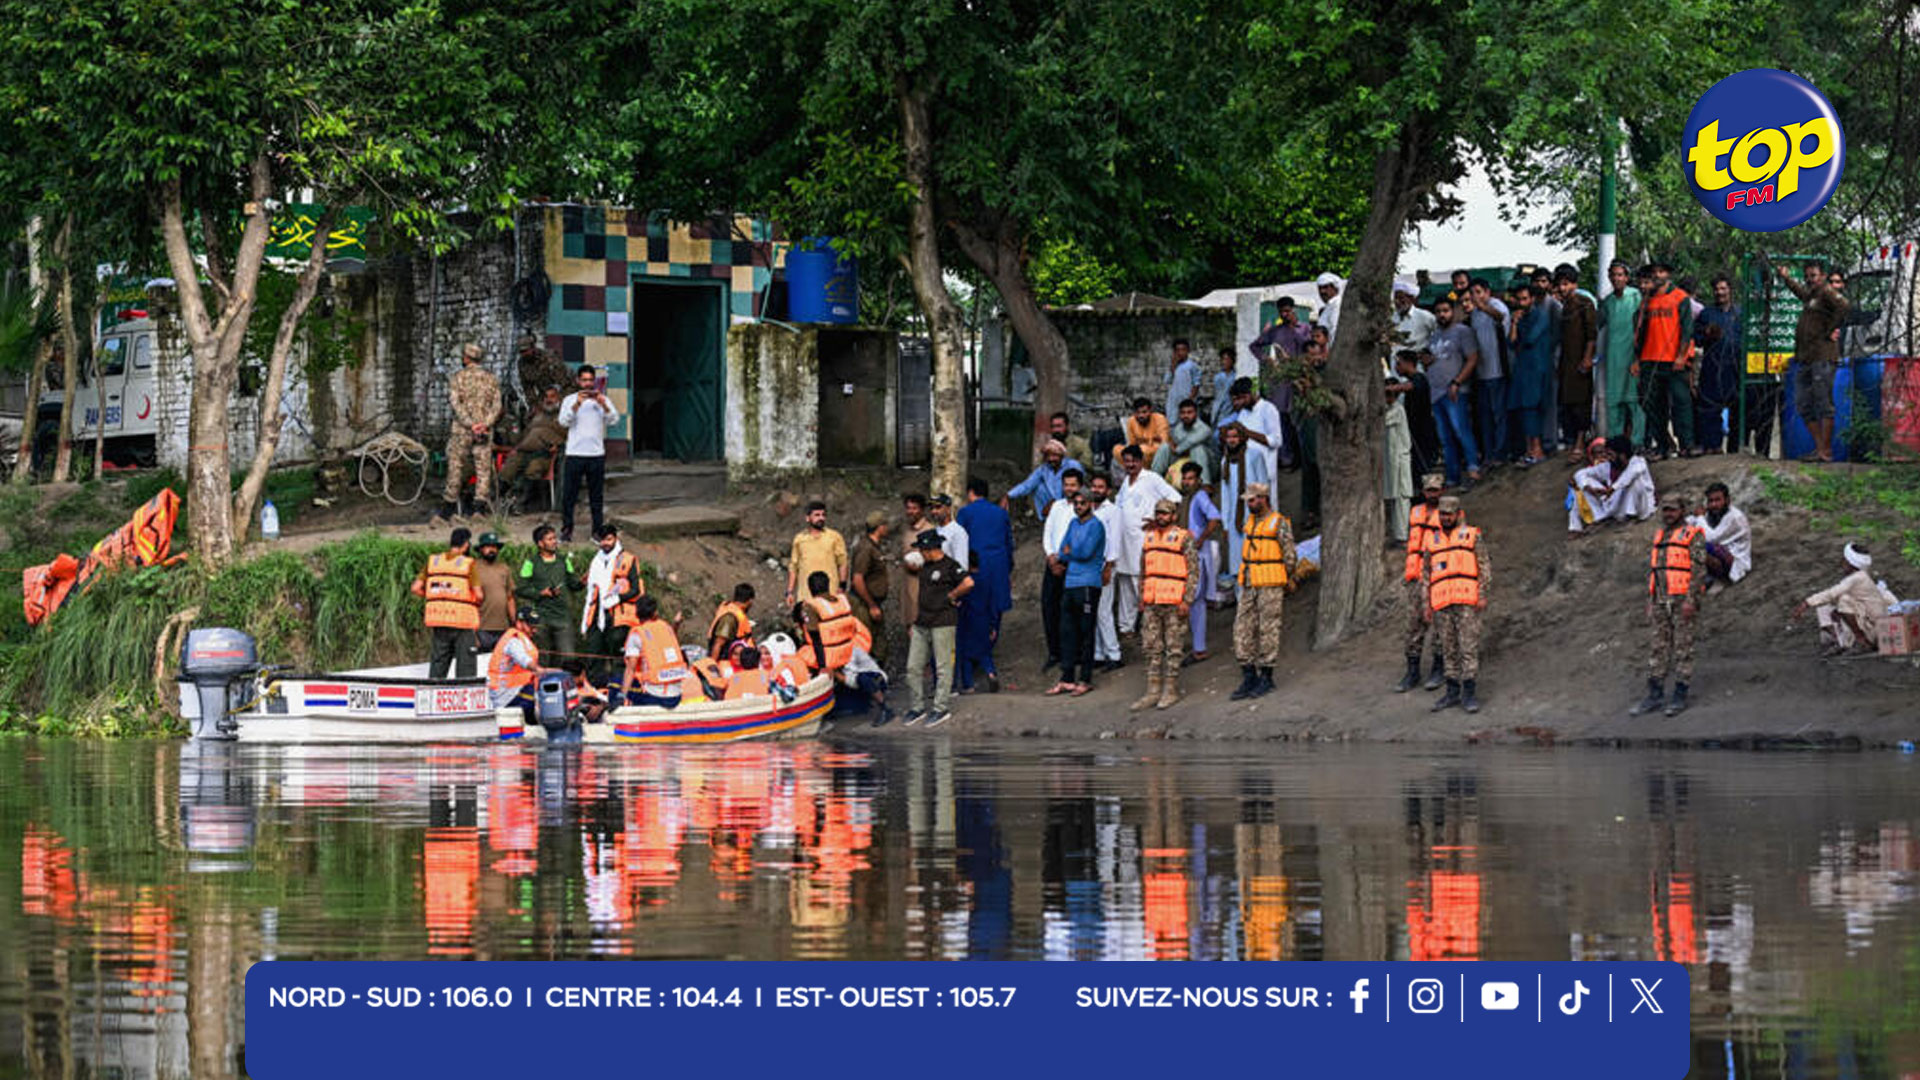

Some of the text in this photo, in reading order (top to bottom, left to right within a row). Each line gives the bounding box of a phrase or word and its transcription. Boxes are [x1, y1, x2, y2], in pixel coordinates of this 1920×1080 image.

[86, 405, 122, 425] RANERS
[350, 689, 376, 709] PDMA
[436, 688, 487, 712] RESCUE 1122
